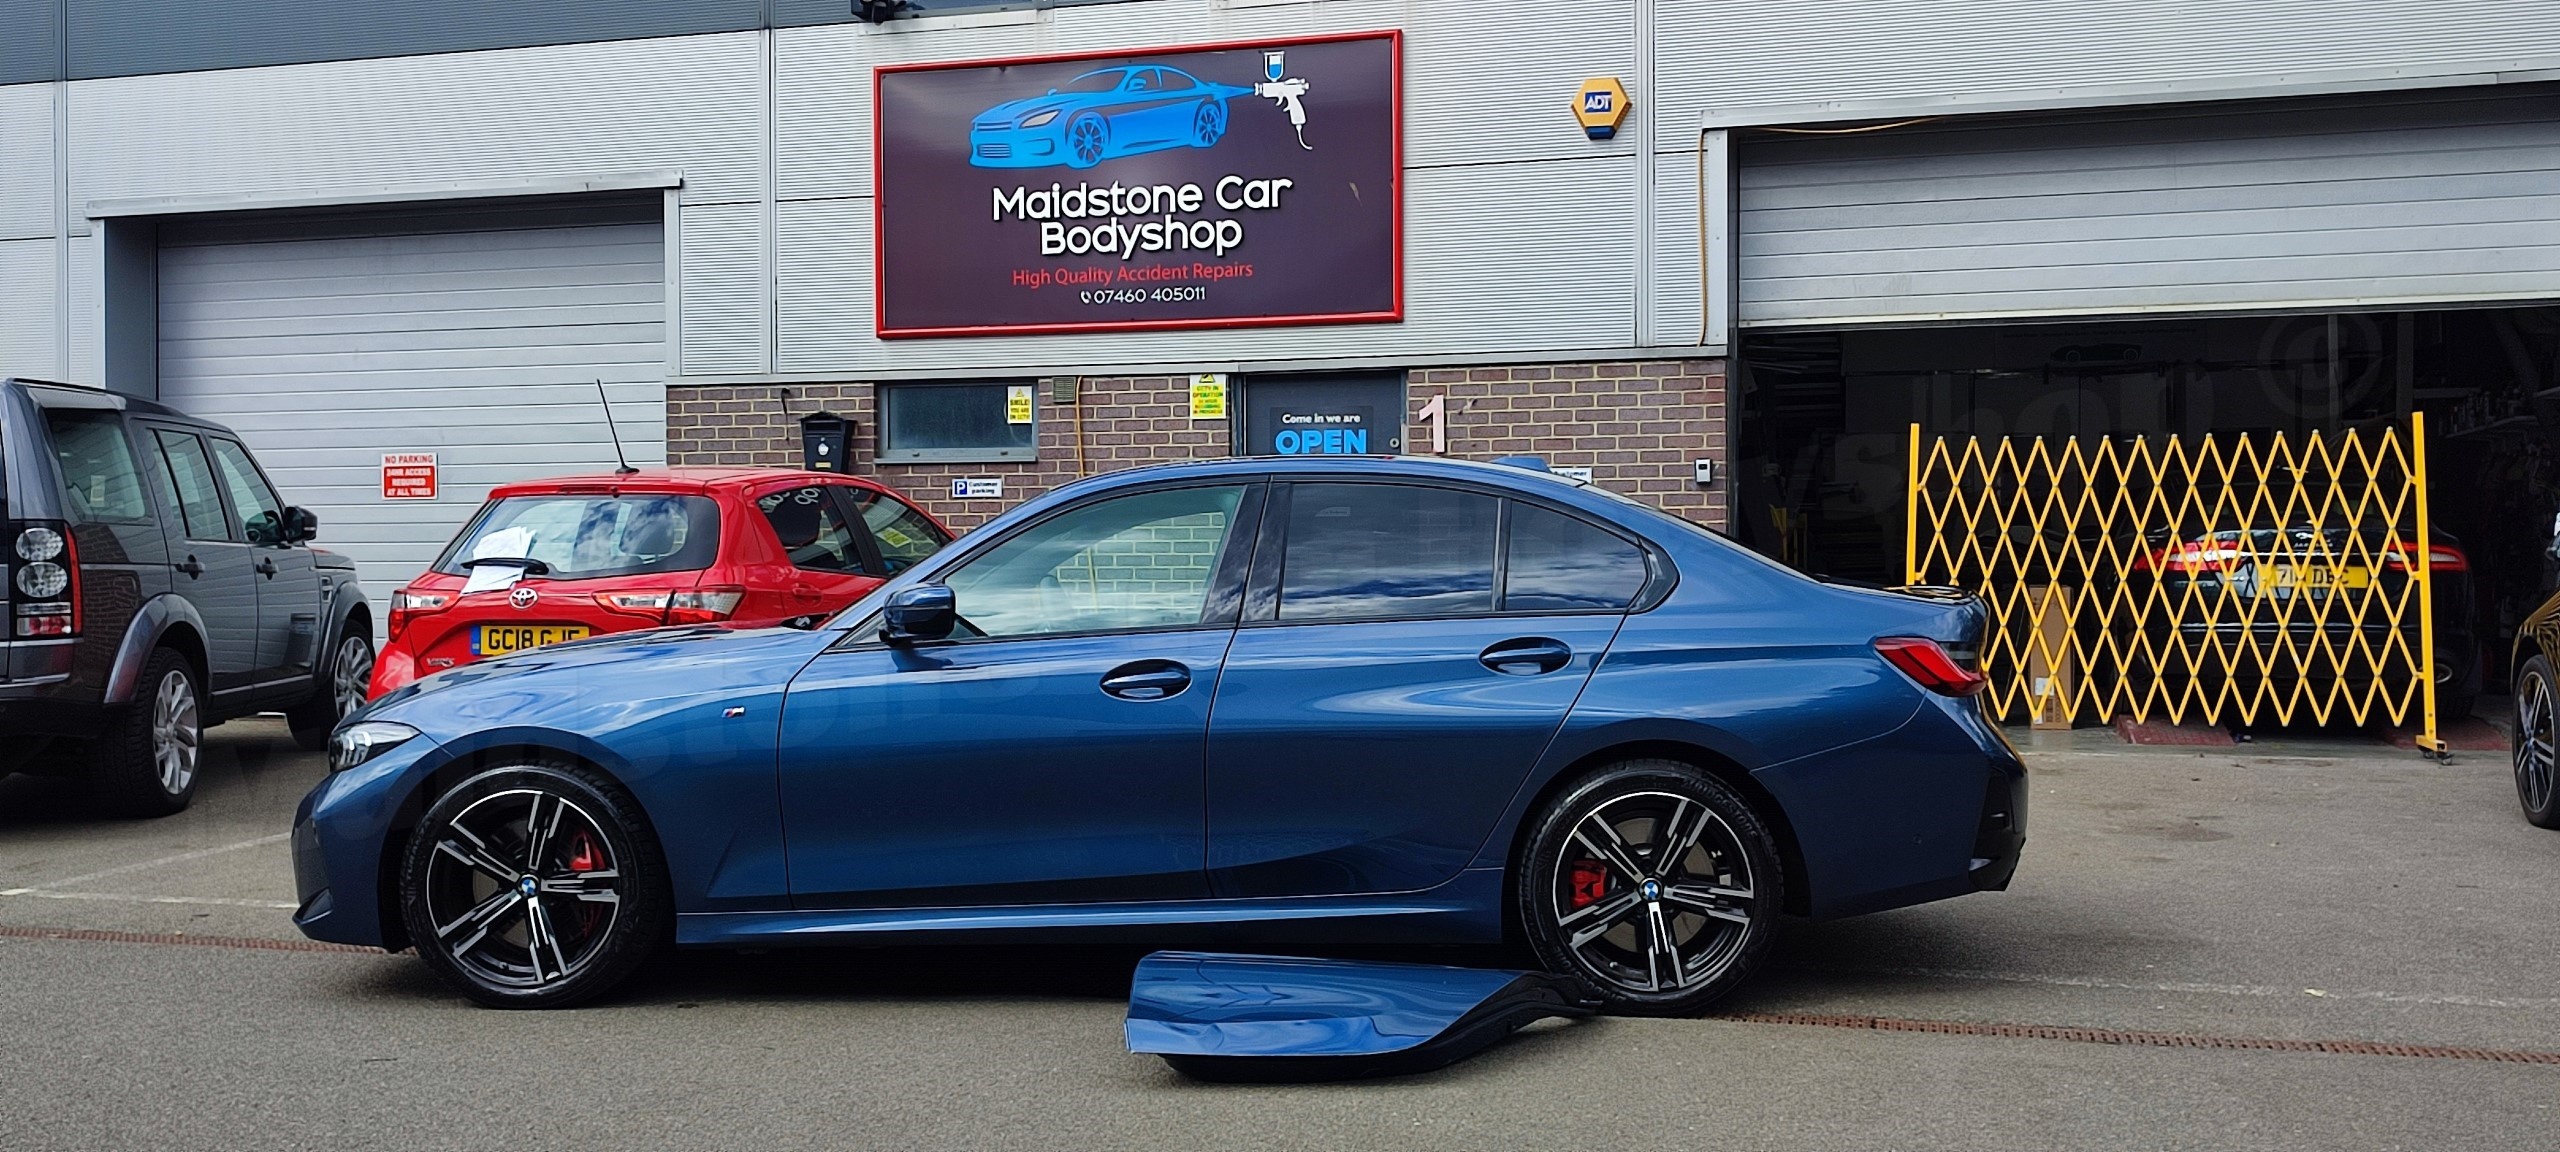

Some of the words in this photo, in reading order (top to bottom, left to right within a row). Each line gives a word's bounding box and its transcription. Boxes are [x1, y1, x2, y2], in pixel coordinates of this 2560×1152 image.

[1585, 94, 1612, 110] ADT
[993, 180, 1203, 221] Maidstone
[1215, 176, 1293, 210] Car
[1041, 214, 1243, 260] Bodyshop
[1012, 268, 1051, 289] High
[1055, 265, 1114, 287] Quality
[1117, 263, 1188, 282] Accident
[1193, 261, 1253, 281] Repairs
[1093, 288, 1146, 304] 07460
[1151, 286, 1206, 302] 405011
[1282, 413, 1313, 424] Come
[1314, 412, 1324, 423] in
[1326, 415, 1341, 423] we
[1343, 415, 1361, 423] are
[1419, 395, 1445, 453] 1
[1275, 429, 1367, 454] OPEN
[399, 455, 433, 464] PARKING
[488, 628, 533, 650] GC18
